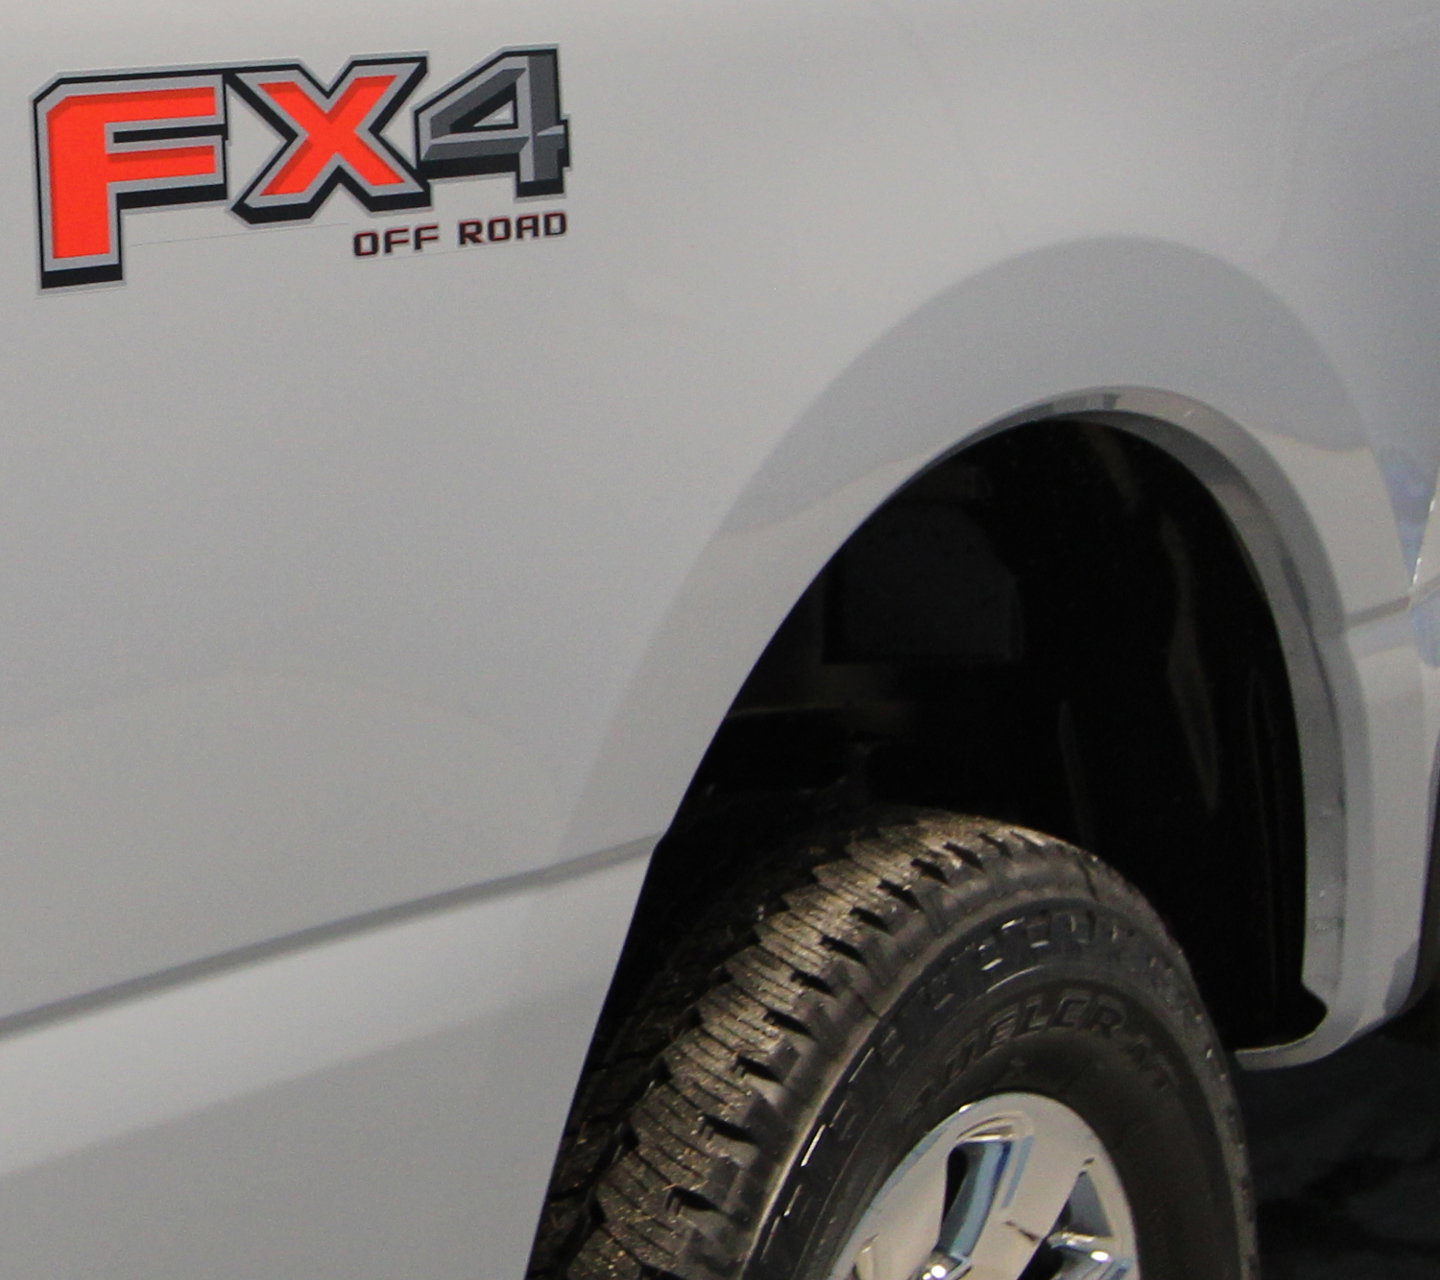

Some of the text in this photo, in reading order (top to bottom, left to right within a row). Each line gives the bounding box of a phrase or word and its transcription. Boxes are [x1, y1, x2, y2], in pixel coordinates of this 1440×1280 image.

[32, 44, 570, 293] FX4
[353, 211, 568, 258] OFF ROAD
